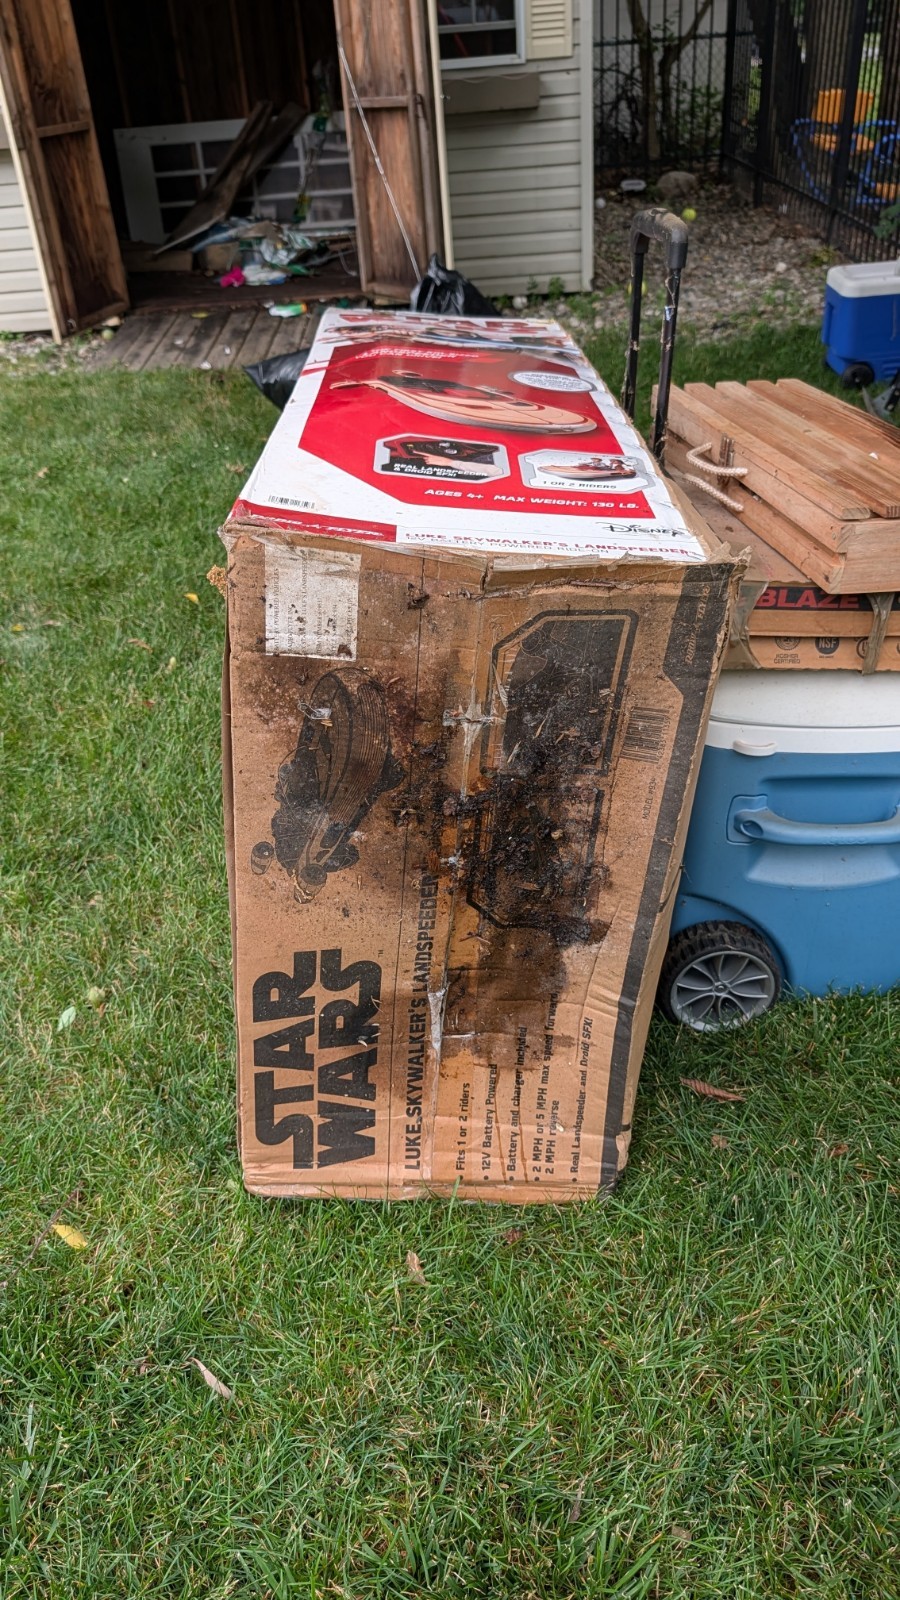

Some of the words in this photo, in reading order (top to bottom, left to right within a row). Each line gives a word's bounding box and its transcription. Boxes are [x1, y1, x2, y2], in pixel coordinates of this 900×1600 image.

[422, 466, 488, 477] LANDSPEEDER
[424, 489, 462, 497] AGES
[494, 494, 525, 503] MAX
[530, 497, 587, 507] WEIGHT:
[326, 526, 384, 537] FLYER
[453, 535, 569, 547] SKYWALKER'S
[574, 543, 688, 555] LANDSPEEDER
[757, 589, 860, 609] BLAZE
[818, 637, 837, 649] NSF
[642, 796, 654, 820] MODEL
[412, 873, 439, 994] LANDSPEEDER
[582, 1017, 594, 1041] SFX!
[405, 995, 428, 1121] SKYWALKER'S
[516, 1026, 528, 1066] included
[544, 1034, 554, 1061] speed
[580, 1042, 589, 1066] Droid
[253, 950, 317, 1169] STAR
[317, 948, 383, 1169] WARS
[485, 1063, 498, 1107] Powered
[512, 1067, 525, 1107] charger
[541, 1066, 549, 1085] max
[579, 1069, 587, 1088] and
[459, 1082, 470, 1112] riders
[536, 1087, 548, 1110] MPH
[482, 1109, 496, 1149] Battery
[511, 1109, 519, 1128] and
[537, 1123, 544, 1134] or
[549, 1100, 560, 1134] reverse
[572, 1089, 586, 1149] Landspeeder
[460, 1126, 468, 1137] or
[405, 1122, 421, 1171] LUKE
[507, 1131, 519, 1172] Battery
[532, 1138, 543, 1160] MPH
[545, 1139, 556, 1164] MPH
[456, 1150, 466, 1171] Fits
[482, 1152, 491, 1171] 12V
[532, 1165, 541, 1173] 2
[570, 1153, 579, 1173] Real
